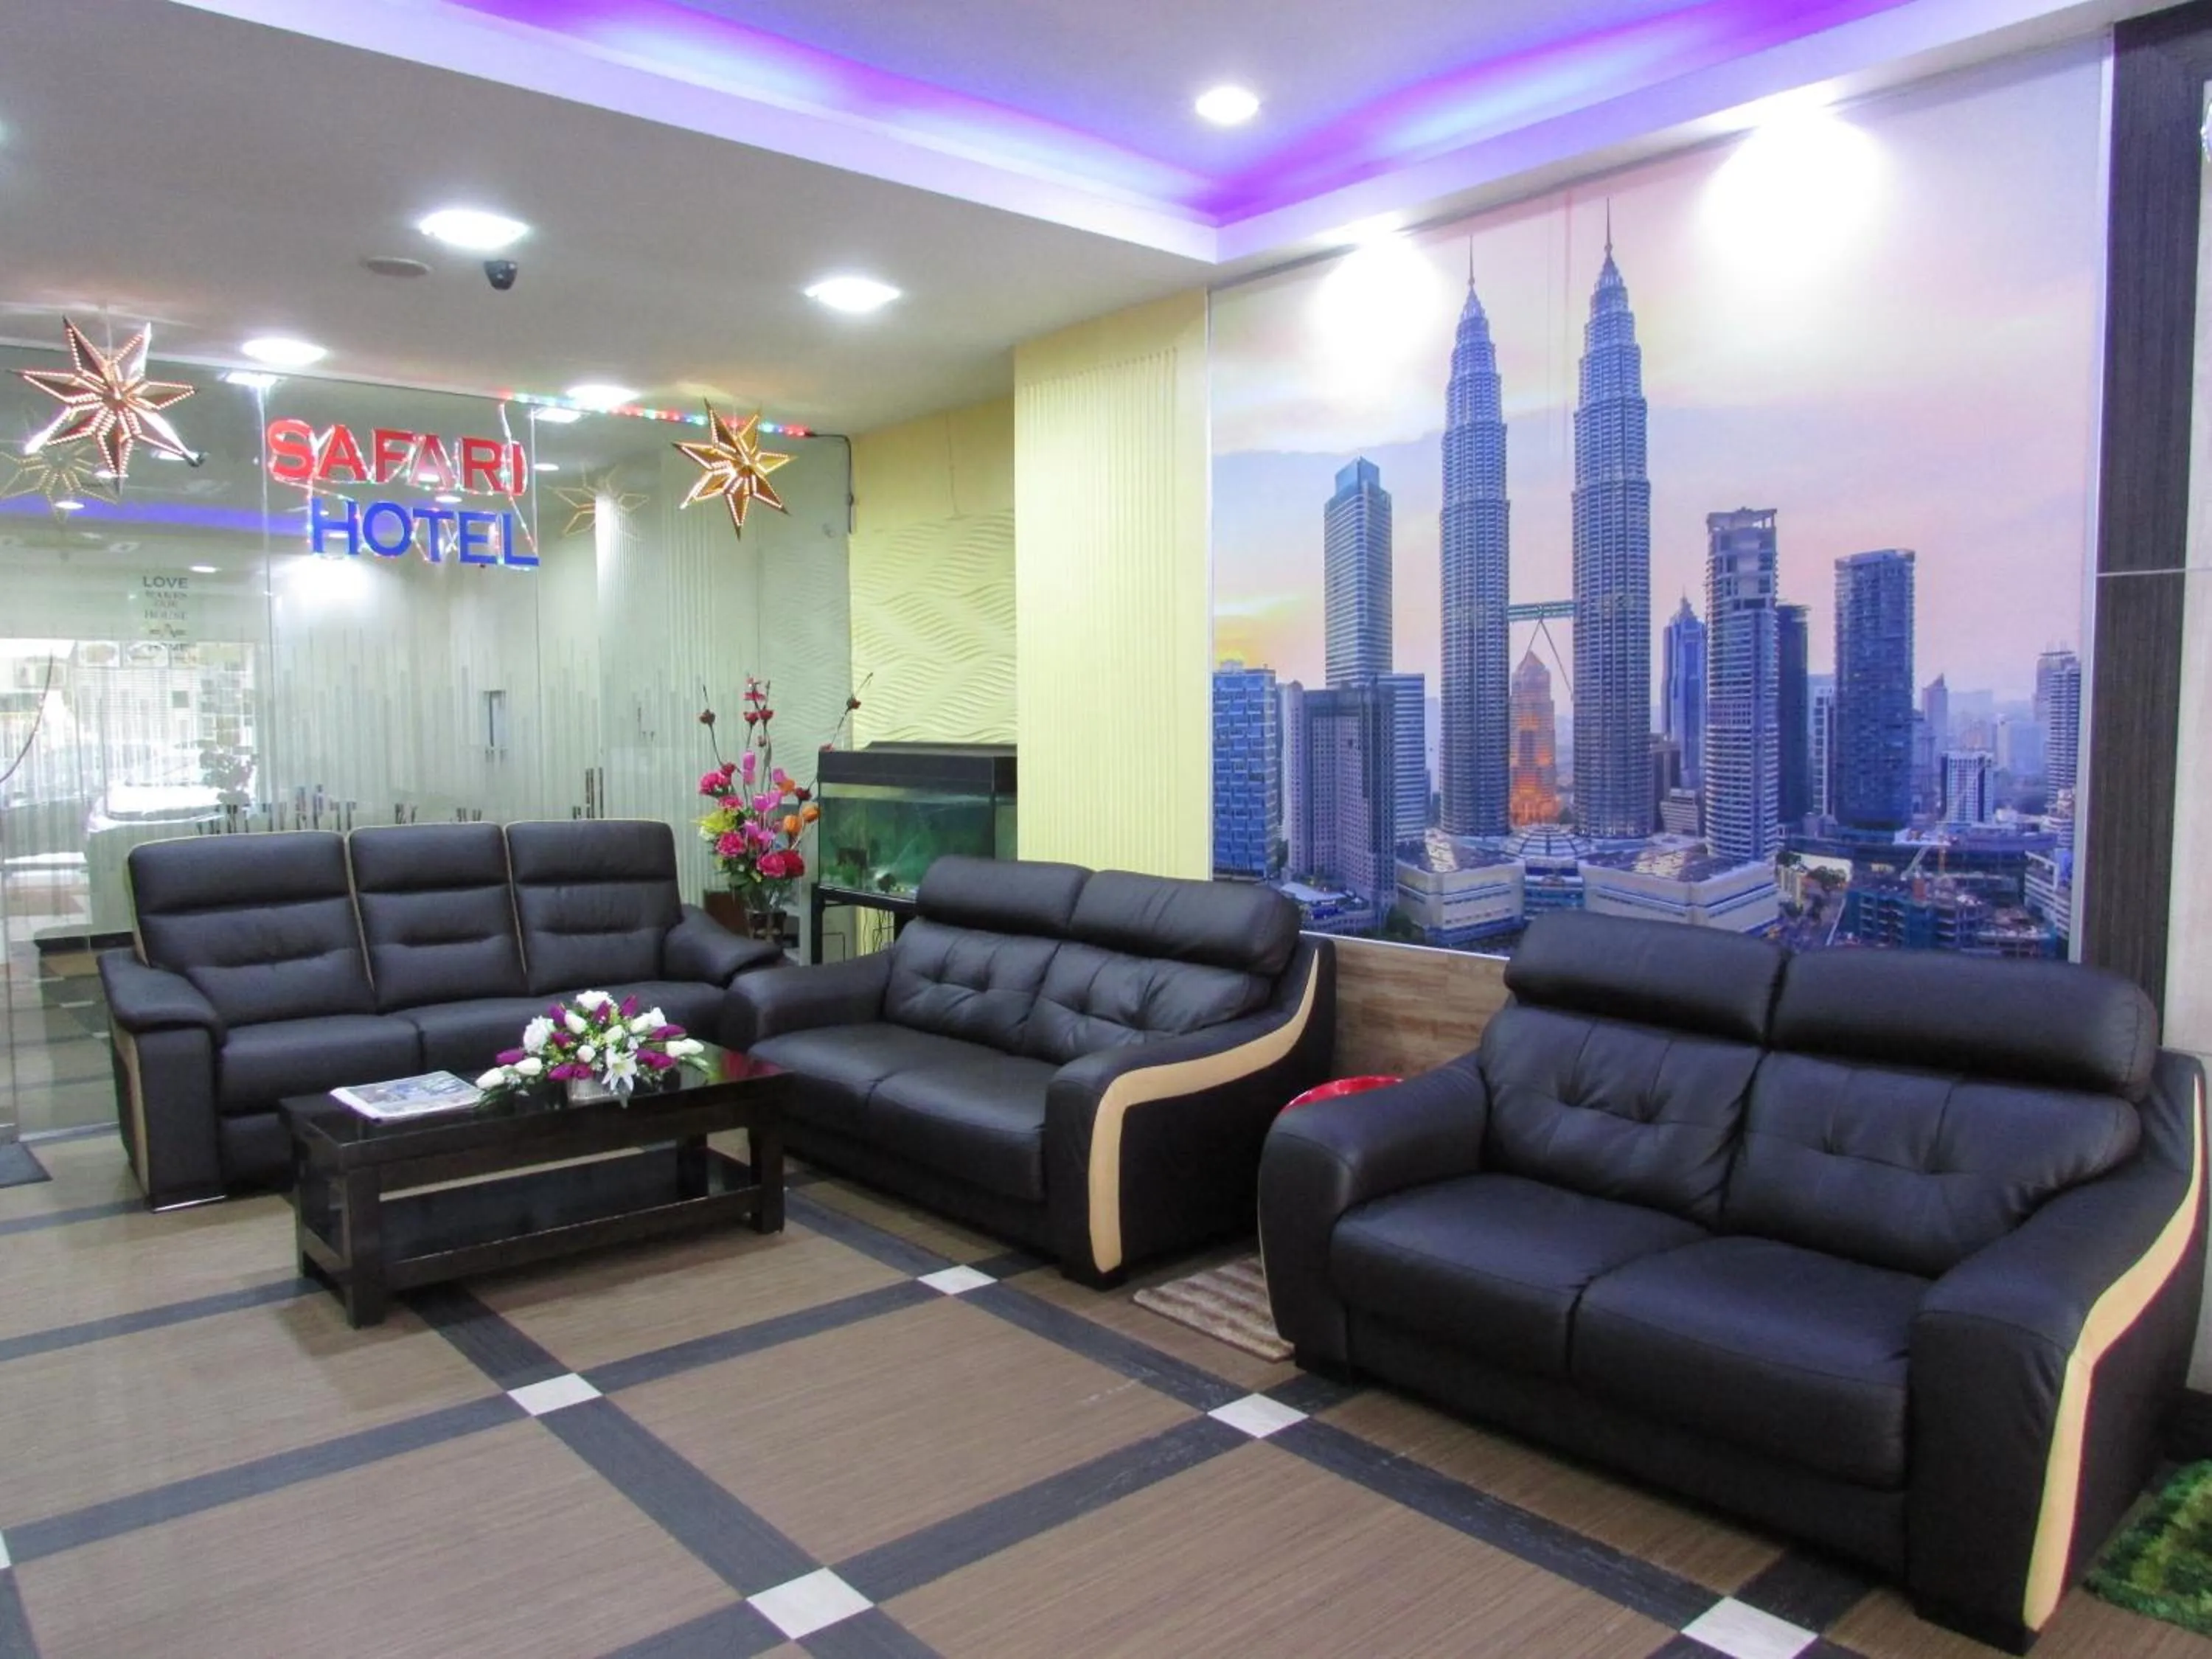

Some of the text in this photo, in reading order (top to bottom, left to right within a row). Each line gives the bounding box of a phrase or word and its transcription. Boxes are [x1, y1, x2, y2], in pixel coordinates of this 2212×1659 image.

[268, 419, 527, 495] SAFARI
[310, 497, 540, 567] HOTEL
[142, 576, 189, 589] LOVE
